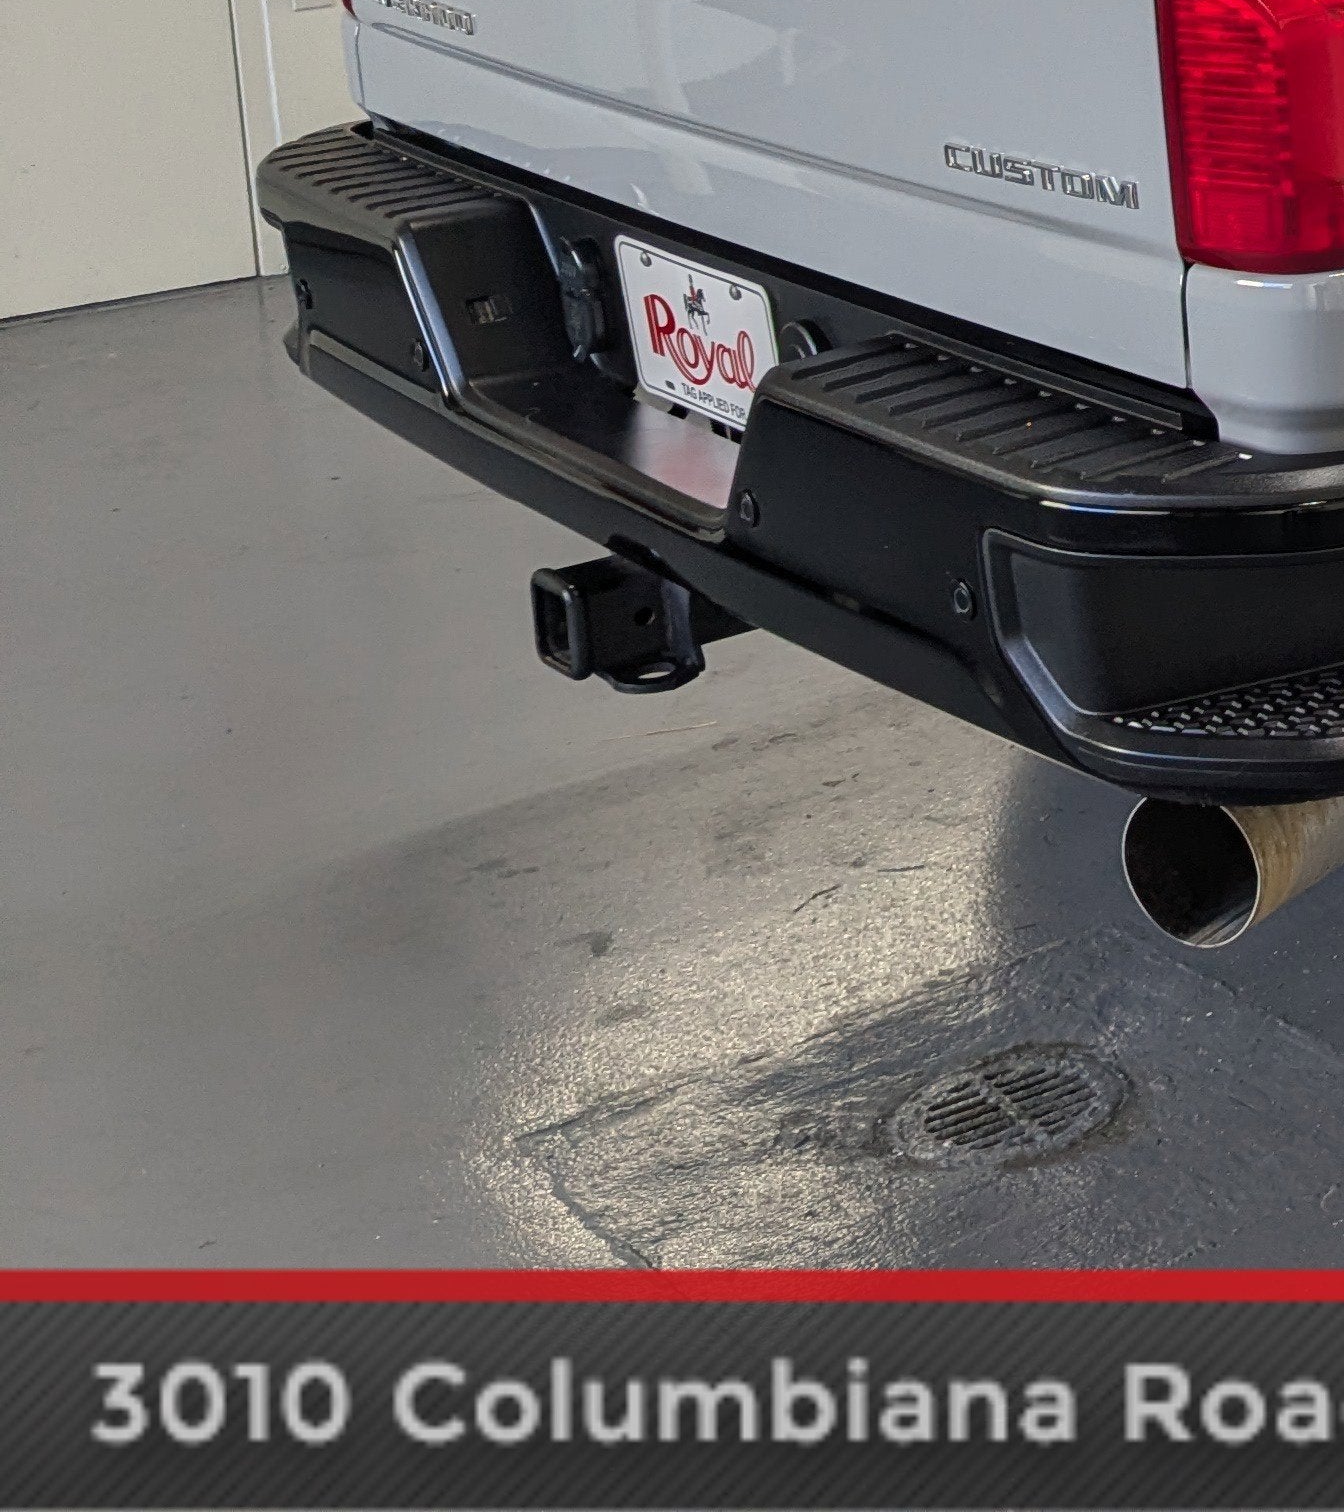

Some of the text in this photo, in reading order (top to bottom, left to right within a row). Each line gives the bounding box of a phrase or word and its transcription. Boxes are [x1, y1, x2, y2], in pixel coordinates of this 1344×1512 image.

[943, 141, 1141, 210] CUSTOM
[643, 293, 757, 393] Royal
[681, 382, 746, 419] TAG APPLIED FOR
